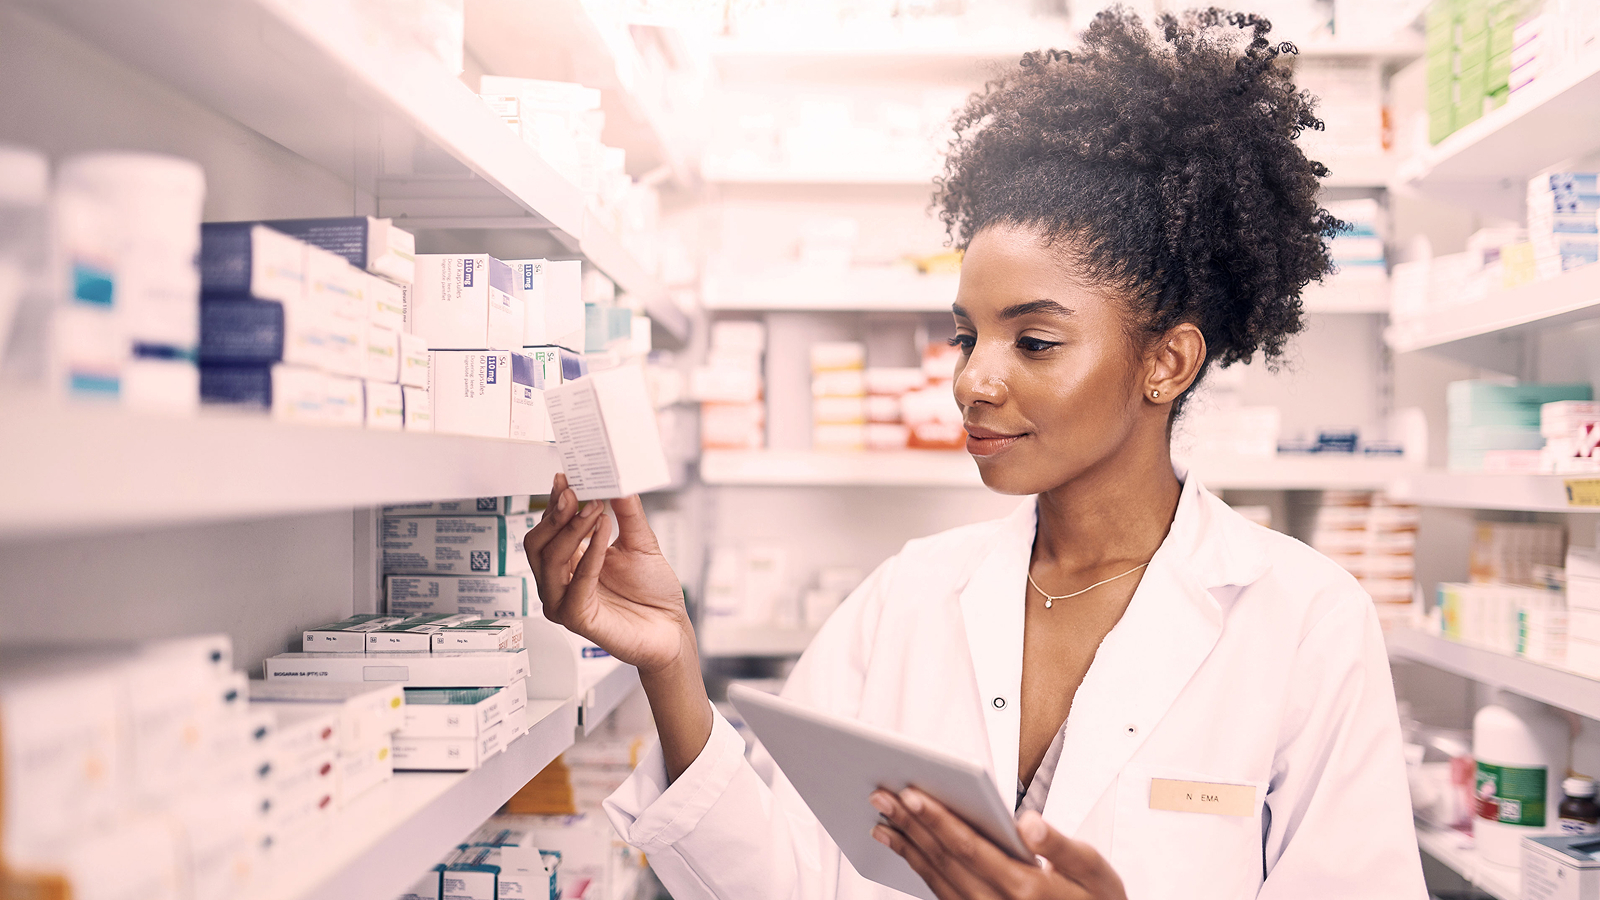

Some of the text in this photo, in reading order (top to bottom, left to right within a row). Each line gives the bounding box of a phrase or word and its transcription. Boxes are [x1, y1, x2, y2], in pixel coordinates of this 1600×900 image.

[456, 258, 463, 268] 60
[464, 260, 473, 286] 110 mg
[524, 277, 532, 289] mg
[478, 355, 486, 396] 60 kapsules
[486, 356, 496, 383] 110 mg
[1201, 794, 1219, 802] EMA
